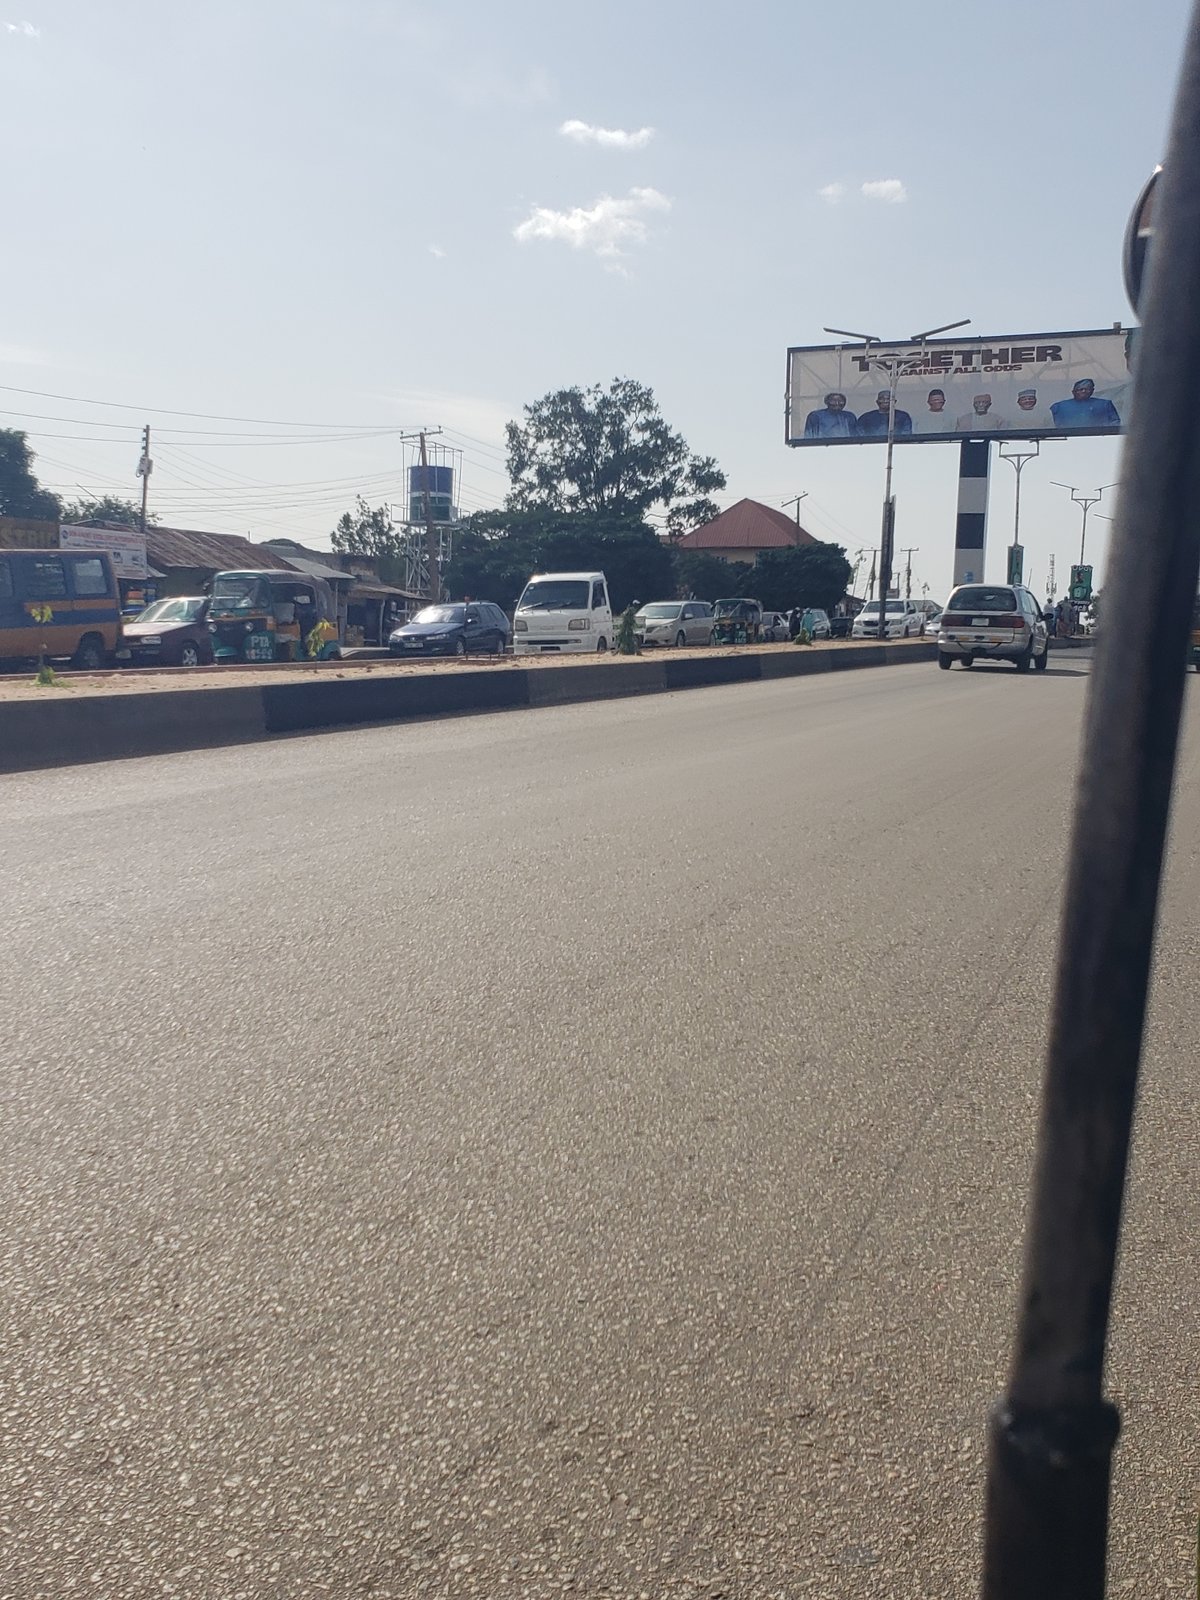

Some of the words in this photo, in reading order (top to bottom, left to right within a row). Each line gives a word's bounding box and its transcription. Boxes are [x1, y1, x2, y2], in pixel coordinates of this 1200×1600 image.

[852, 344, 1063, 372] TOGETHER
[953, 366, 981, 375] ALL
[983, 364, 1022, 373] ODDS
